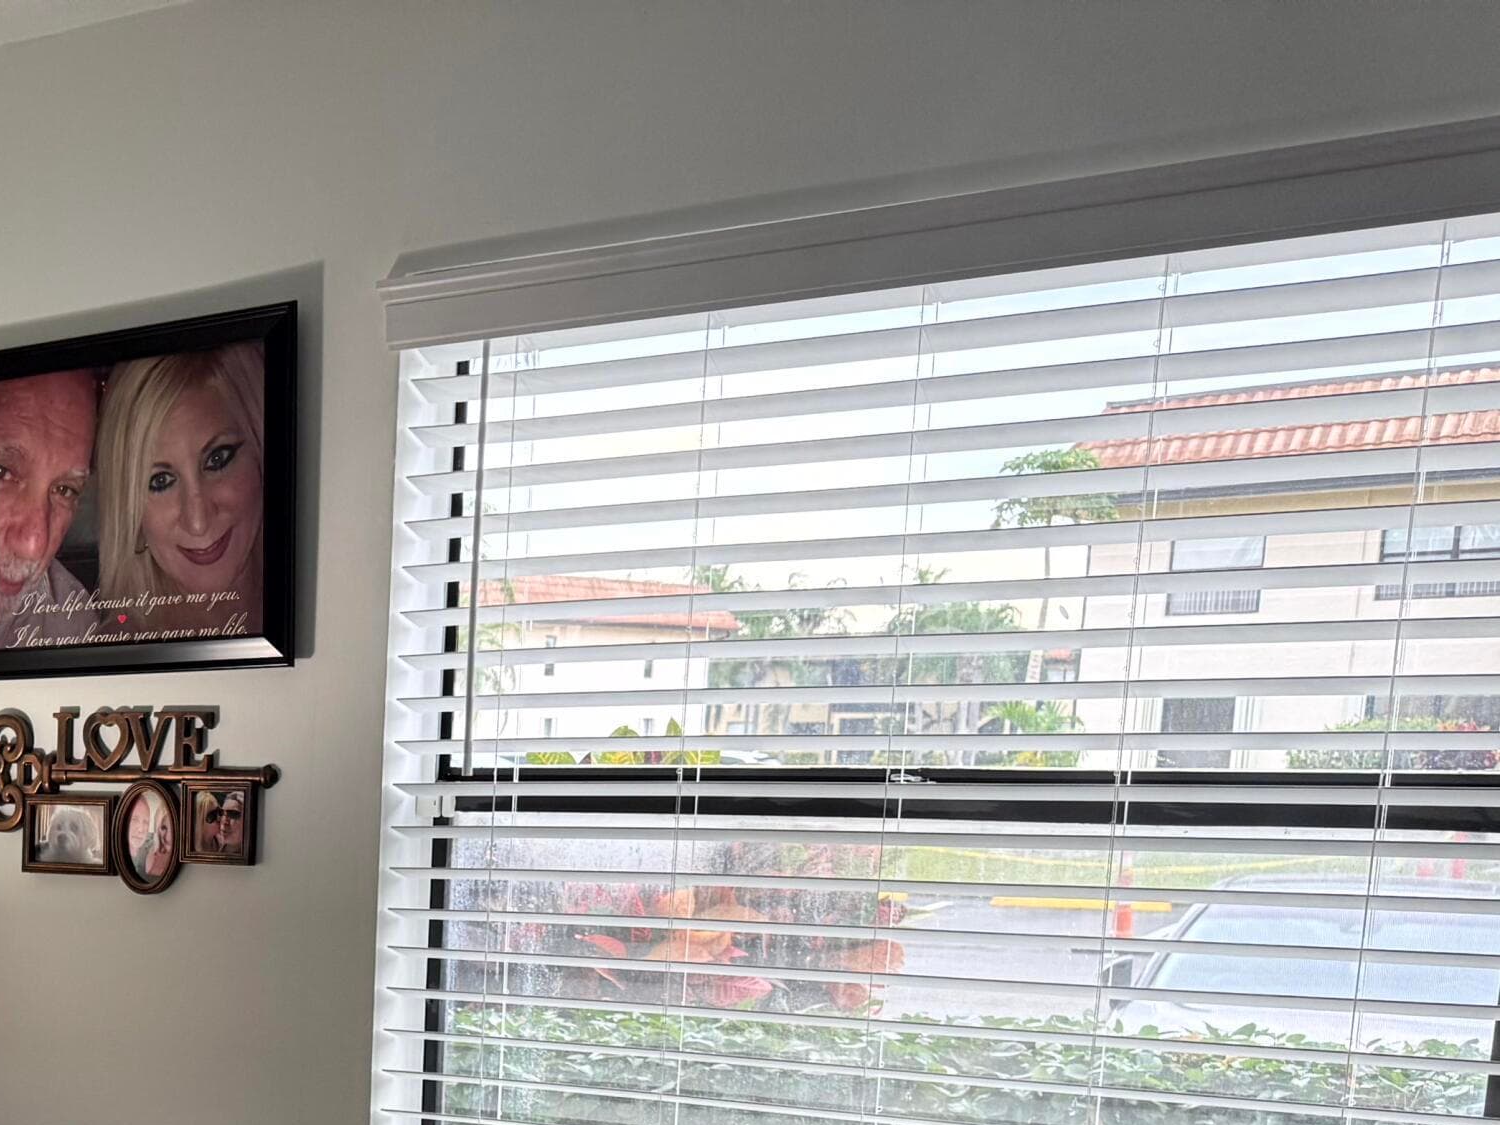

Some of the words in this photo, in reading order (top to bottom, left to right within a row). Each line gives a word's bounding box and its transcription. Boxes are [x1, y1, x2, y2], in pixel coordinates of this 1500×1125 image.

[12, 591, 37, 615] I
[33, 592, 60, 614] love
[61, 588, 85, 620] life
[85, 588, 134, 610] because
[135, 590, 150, 607] it
[145, 594, 183, 615] gave
[186, 592, 209, 603] me
[206, 591, 240, 611] you.
[5, 624, 31, 648] I
[25, 626, 54, 648] love
[82, 622, 131, 645] because
[133, 631, 160, 643] you
[198, 627, 220, 637] me
[221, 611, 248, 635] life.
[51, 709, 216, 772] LOVE
